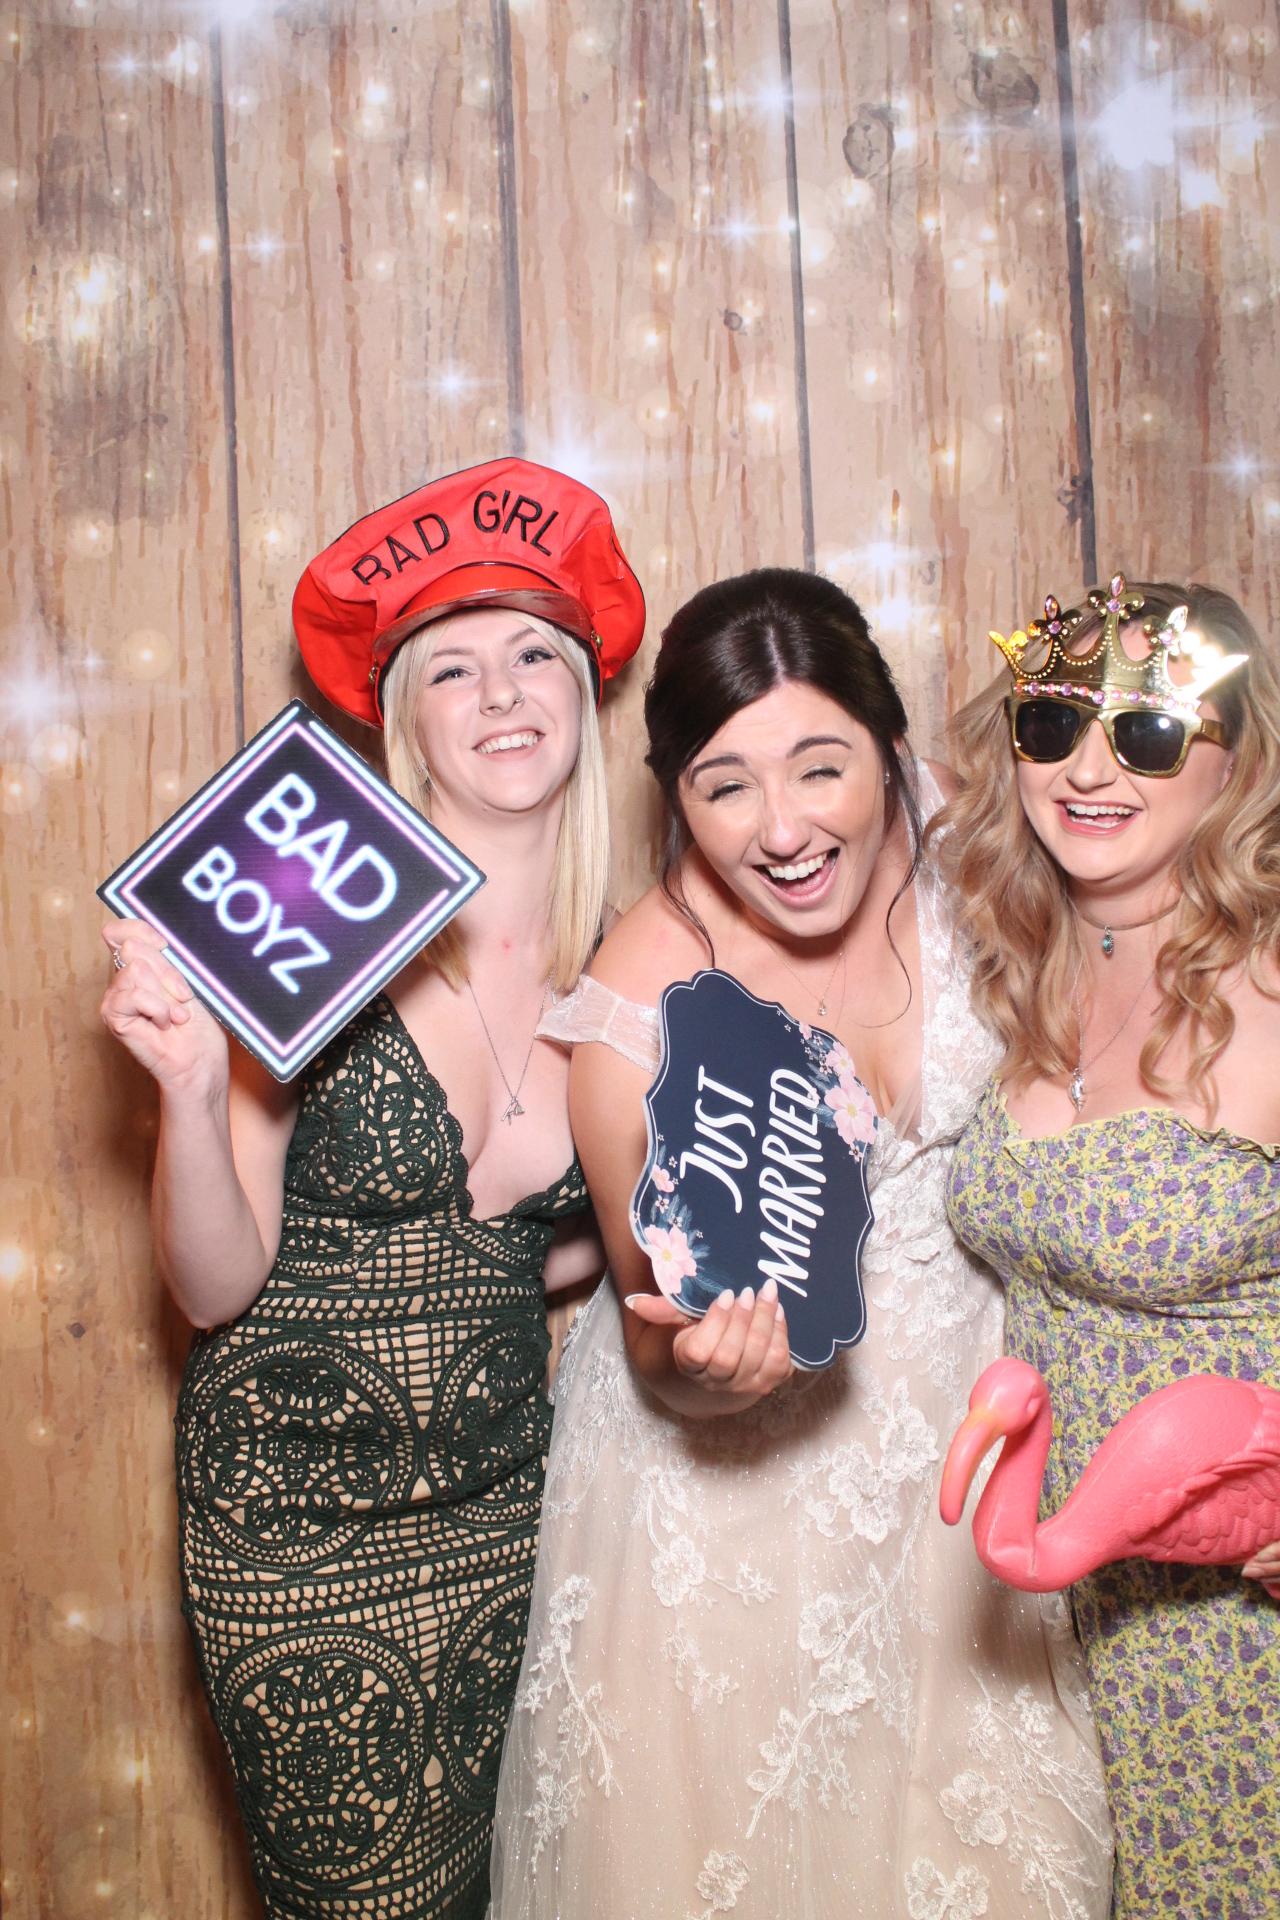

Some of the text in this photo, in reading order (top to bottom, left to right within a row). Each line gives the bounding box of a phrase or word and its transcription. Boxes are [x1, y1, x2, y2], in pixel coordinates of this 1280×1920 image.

[182, 845, 332, 995] BOYZ
[243, 772, 398, 922] BAD
[679, 1065, 755, 1214] JUST
[757, 1068, 827, 1298] MARRIED
